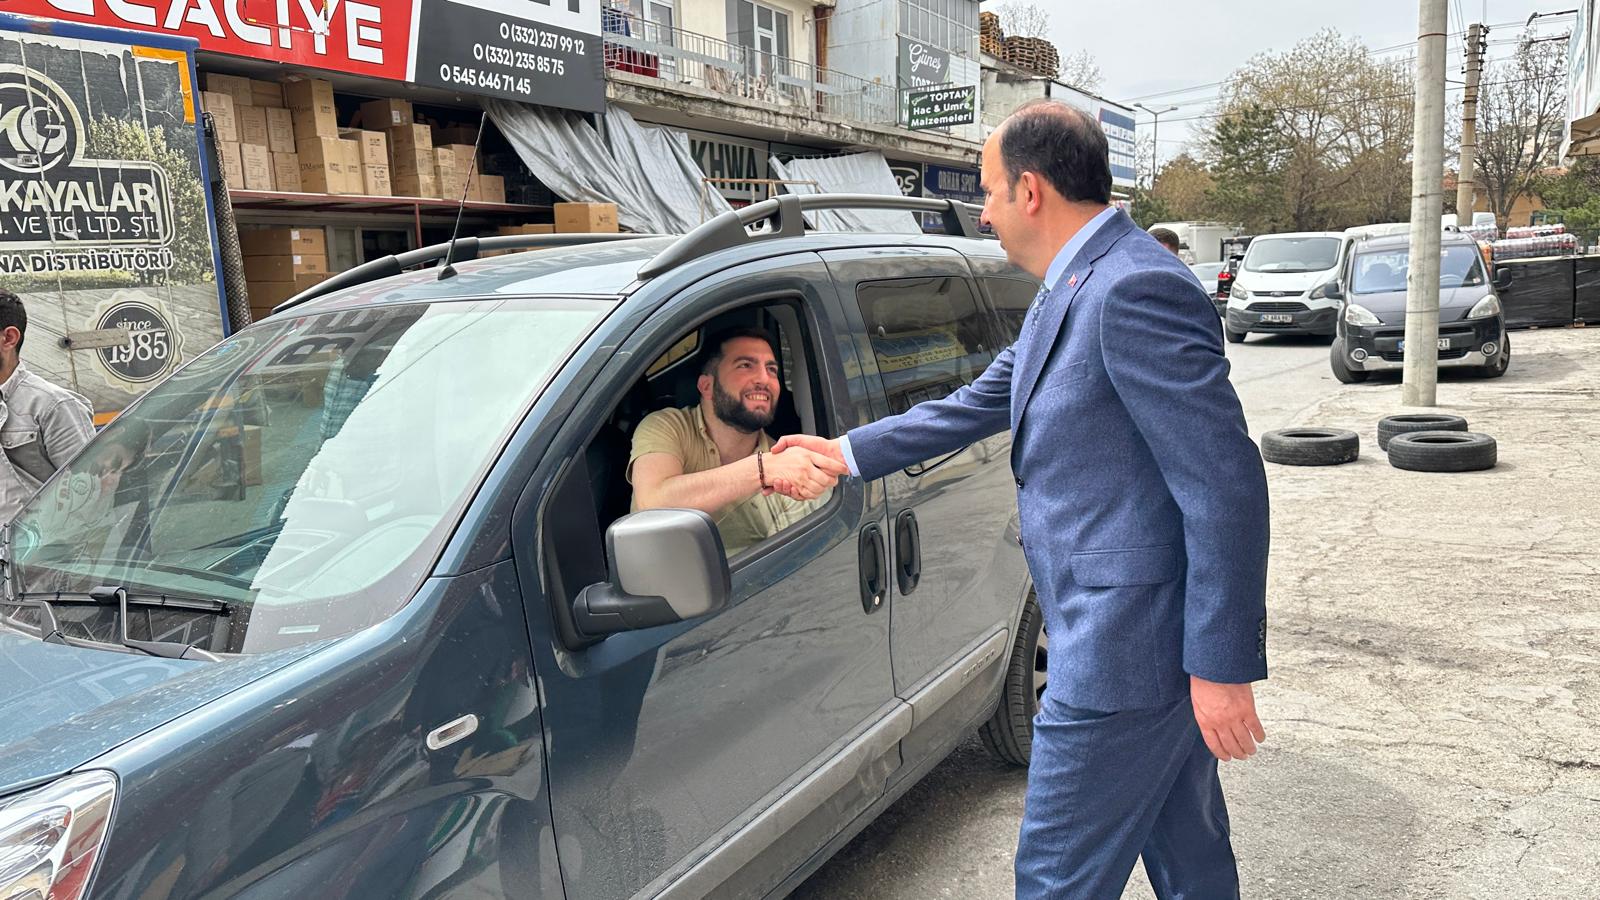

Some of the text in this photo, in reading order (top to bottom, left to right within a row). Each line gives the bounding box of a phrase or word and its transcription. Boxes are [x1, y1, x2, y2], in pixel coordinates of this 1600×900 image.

[499, 22, 585, 56] 0 (332) 237 99 12
[473, 43, 564, 76] 0 (332) 235 85 75
[909, 43, 941, 73] Güneş
[440, 64, 531, 95] 0 545 646 71 45
[930, 89, 969, 102] TOPTAN
[911, 112, 972, 127] Malzemeleri
[913, 101, 970, 115] Hac & Umre
[0, 180, 157, 213] KAYALAR
[14, 216, 43, 234] VE
[88, 217, 126, 234] LTD.
[31, 249, 173, 273] DİSTRİBÜTÖRÜ
[116, 318, 152, 331] since
